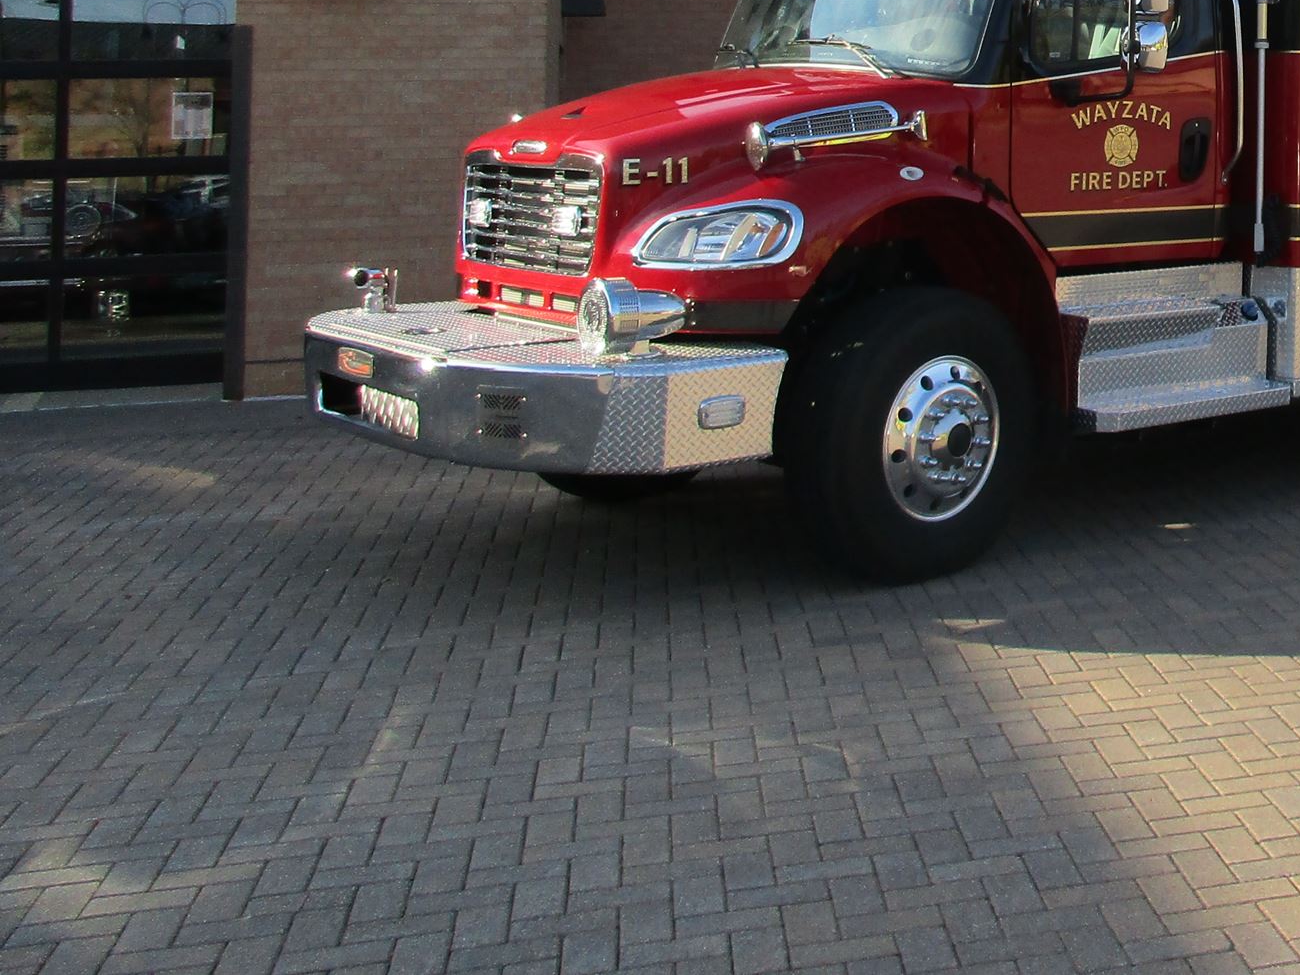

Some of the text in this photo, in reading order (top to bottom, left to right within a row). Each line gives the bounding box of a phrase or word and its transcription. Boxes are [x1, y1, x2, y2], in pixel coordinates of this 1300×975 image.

[1070, 100, 1172, 130] WAYZATA
[622, 157, 688, 185] E-11
[1070, 170, 1168, 191] FIRE DEPT.
